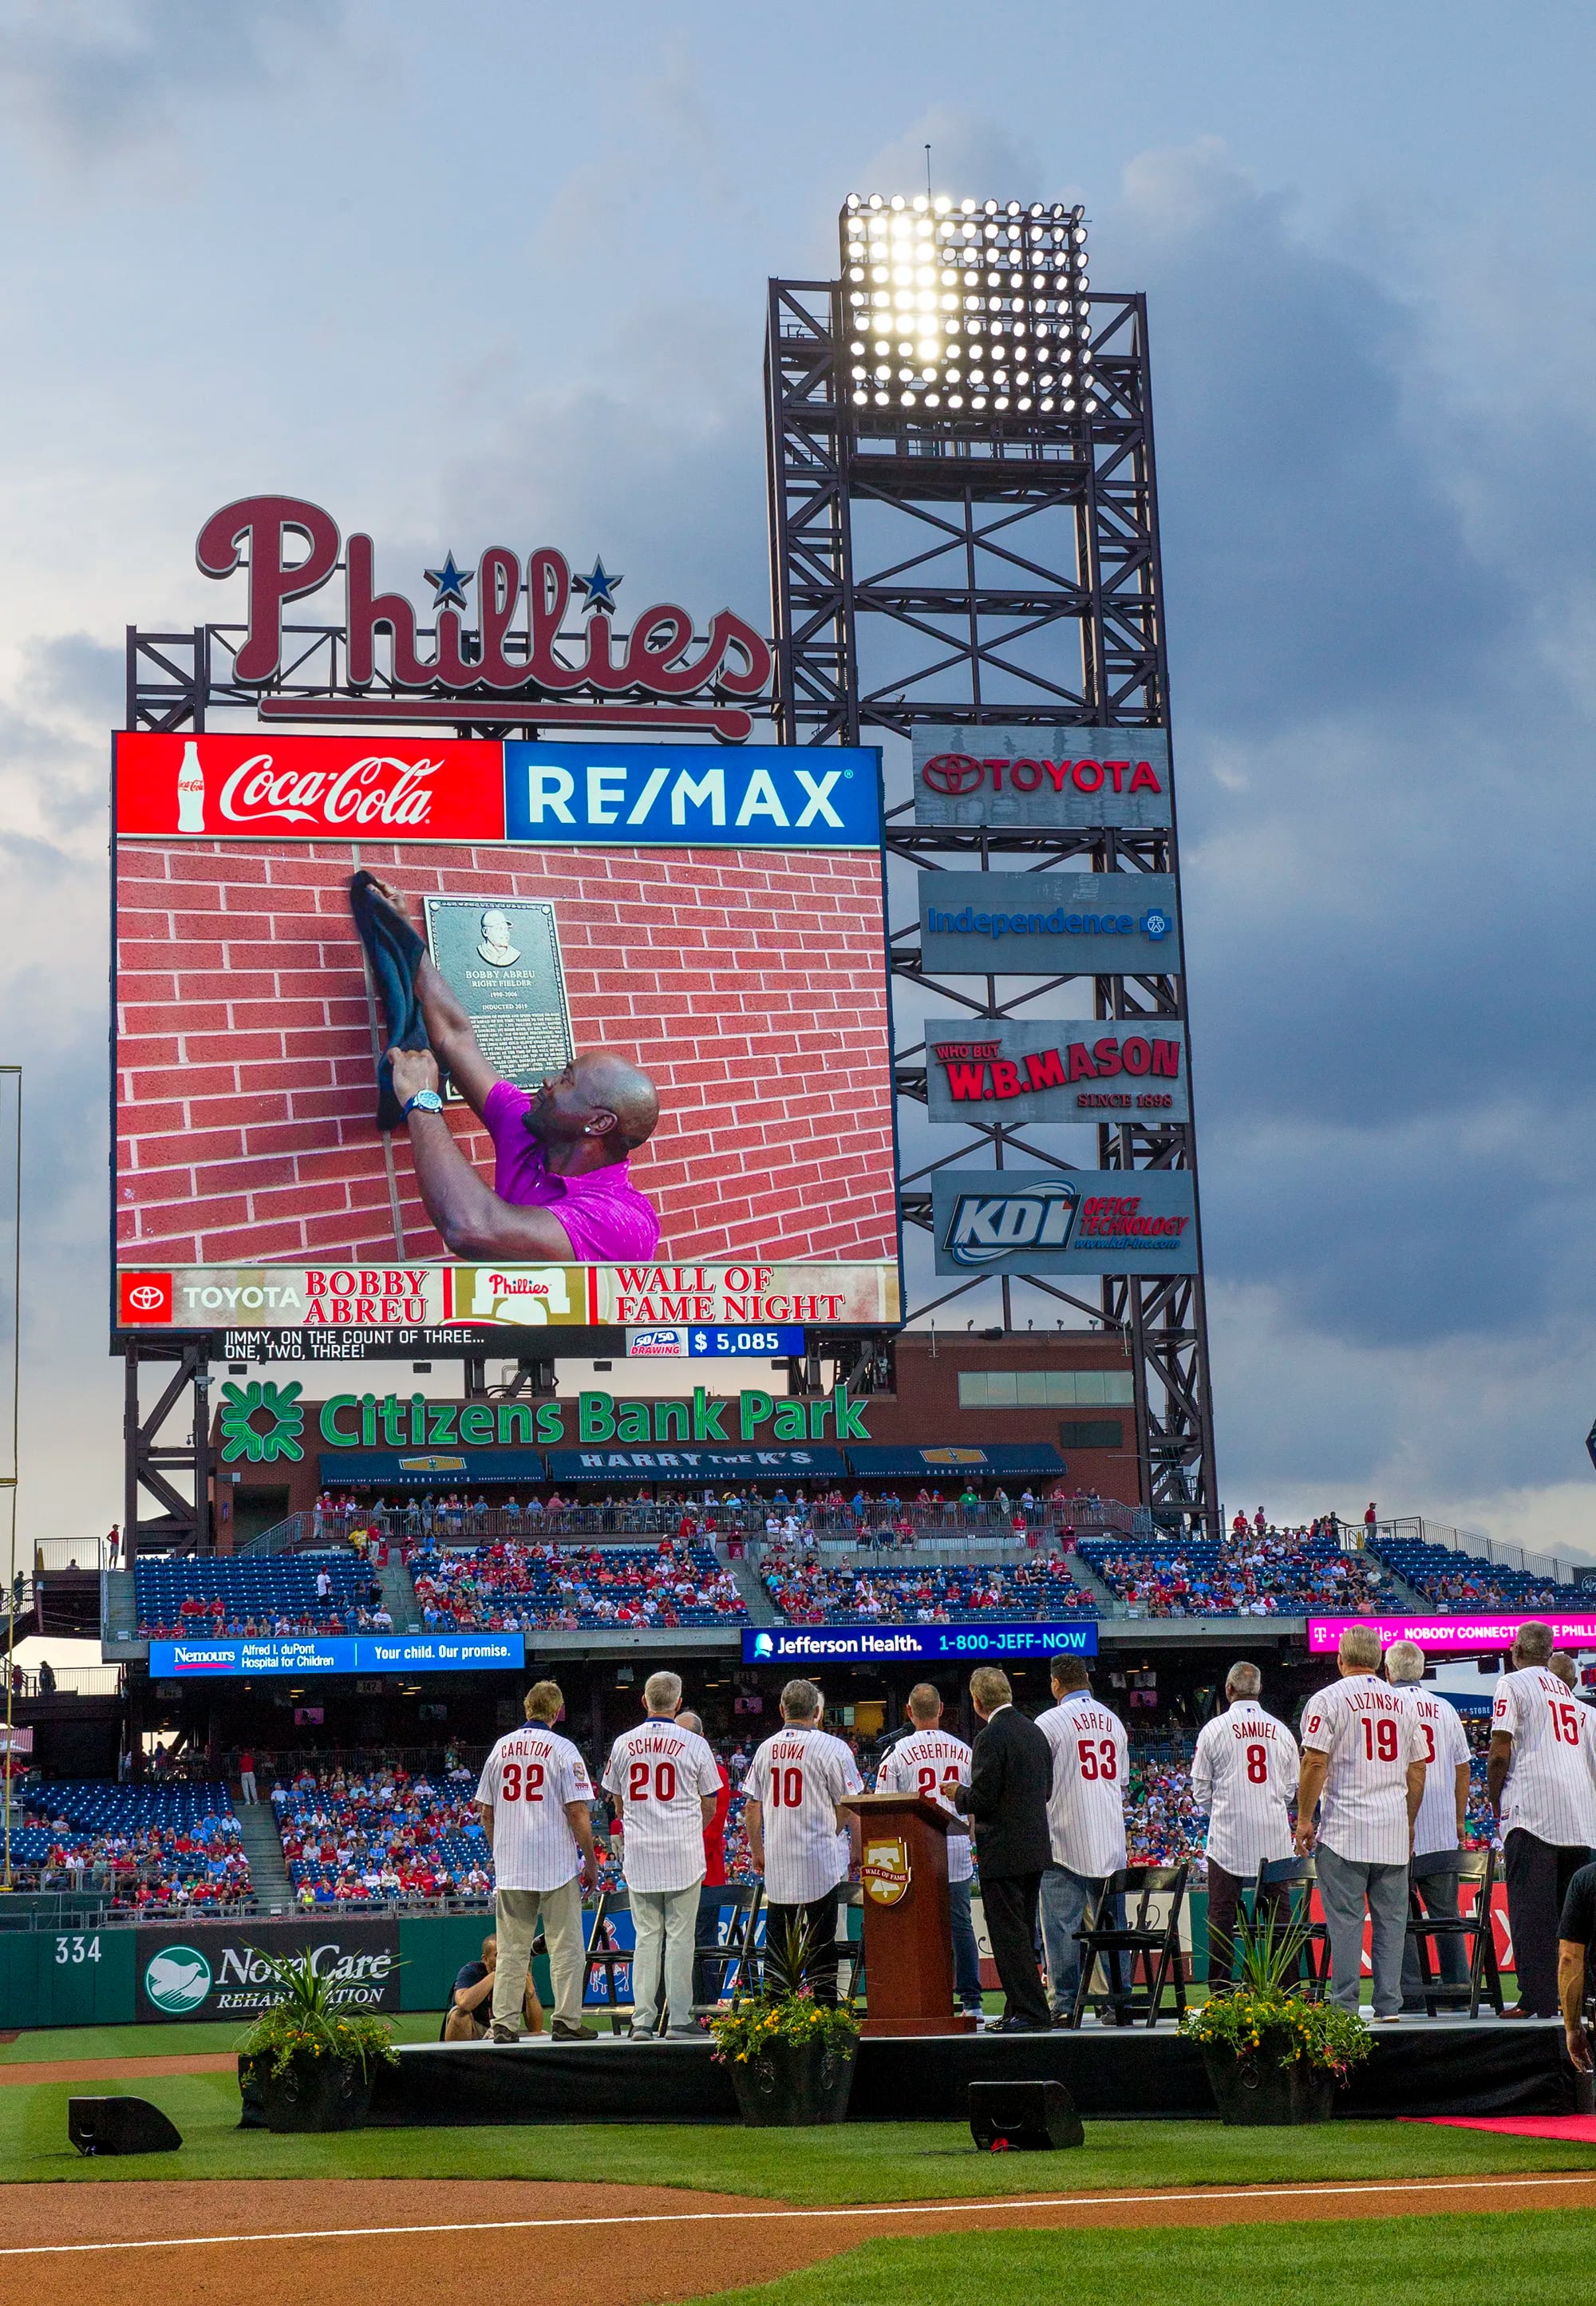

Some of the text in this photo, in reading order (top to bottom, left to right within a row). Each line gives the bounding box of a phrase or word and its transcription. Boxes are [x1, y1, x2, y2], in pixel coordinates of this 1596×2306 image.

[196, 495, 773, 697] Phillies
[983, 758, 1162, 793] TOYOTA
[219, 754, 445, 825] Coca-Cola
[528, 765, 845, 828] RE/MAX
[928, 907, 1134, 939] Independence
[503, 970, 535, 979] ABREU
[936, 1044, 999, 1059] WHO BUT
[1078, 1094, 1173, 1108] SINCE 1898
[1084, 1197, 1141, 1216] OFFICE
[1080, 1216, 1190, 1236] TECHNOLOGY
[1075, 1237, 1181, 1250] www.kdi-inc.com
[304, 1270, 429, 1296] BOBBY
[488, 1274, 549, 1295] Phillies
[615, 1266, 773, 1294] WALL OF
[184, 1287, 302, 1309] TOYOTA
[615, 1294, 845, 1322] FAME NIGHT
[302, 1297, 430, 1325] ABREU
[225, 1330, 485, 1346] JIMMY, ON THE COUNT OF THREE...
[635, 1332, 675, 1346] 50/50
[694, 1331, 779, 1353] $ 5,085
[225, 1344, 365, 1360] ONE, TWO, THREE!
[630, 1345, 680, 1355] DRAWING
[320, 1385, 873, 1447] Citizens Bank Park
[579, 1453, 702, 1467] HARRY
[756, 1452, 813, 1465] K'S
[939, 1632, 1086, 1651] 1-800-JEFF-NOW
[1404, 1627, 1456, 1640] NOBODY
[242, 1644, 270, 1656] Alfred
[281, 1644, 315, 1655] duPont
[374, 1644, 511, 1659] Your child. Our promise.
[778, 1635, 922, 1654] Jefferson Health.
[174, 1647, 235, 1663] Nemours
[242, 1655, 334, 1669] Hospital for Children
[1538, 1676, 1571, 1698] ALLEN
[1345, 1692, 1404, 1715] LUZINSKI
[1469, 1706, 1491, 1715] STORE
[1073, 1713, 1112, 1733] ABREU
[1232, 1722, 1277, 1740] SAMUEL
[1548, 1699, 1579, 1746] 15
[628, 1737, 685, 1757] SCHMIDT
[1361, 1717, 1398, 1762] 19
[501, 1741, 553, 1759] CARLTON
[772, 1743, 804, 1760] BOWA
[900, 1743, 970, 1766] LIEBERTHAL
[1077, 1739, 1117, 1781] 53
[1246, 1744, 1267, 1784] 8
[502, 1763, 544, 1802] 32
[630, 1762, 676, 1802] 20
[770, 1766, 803, 1808] 10
[56, 1936, 101, 1964] 334
